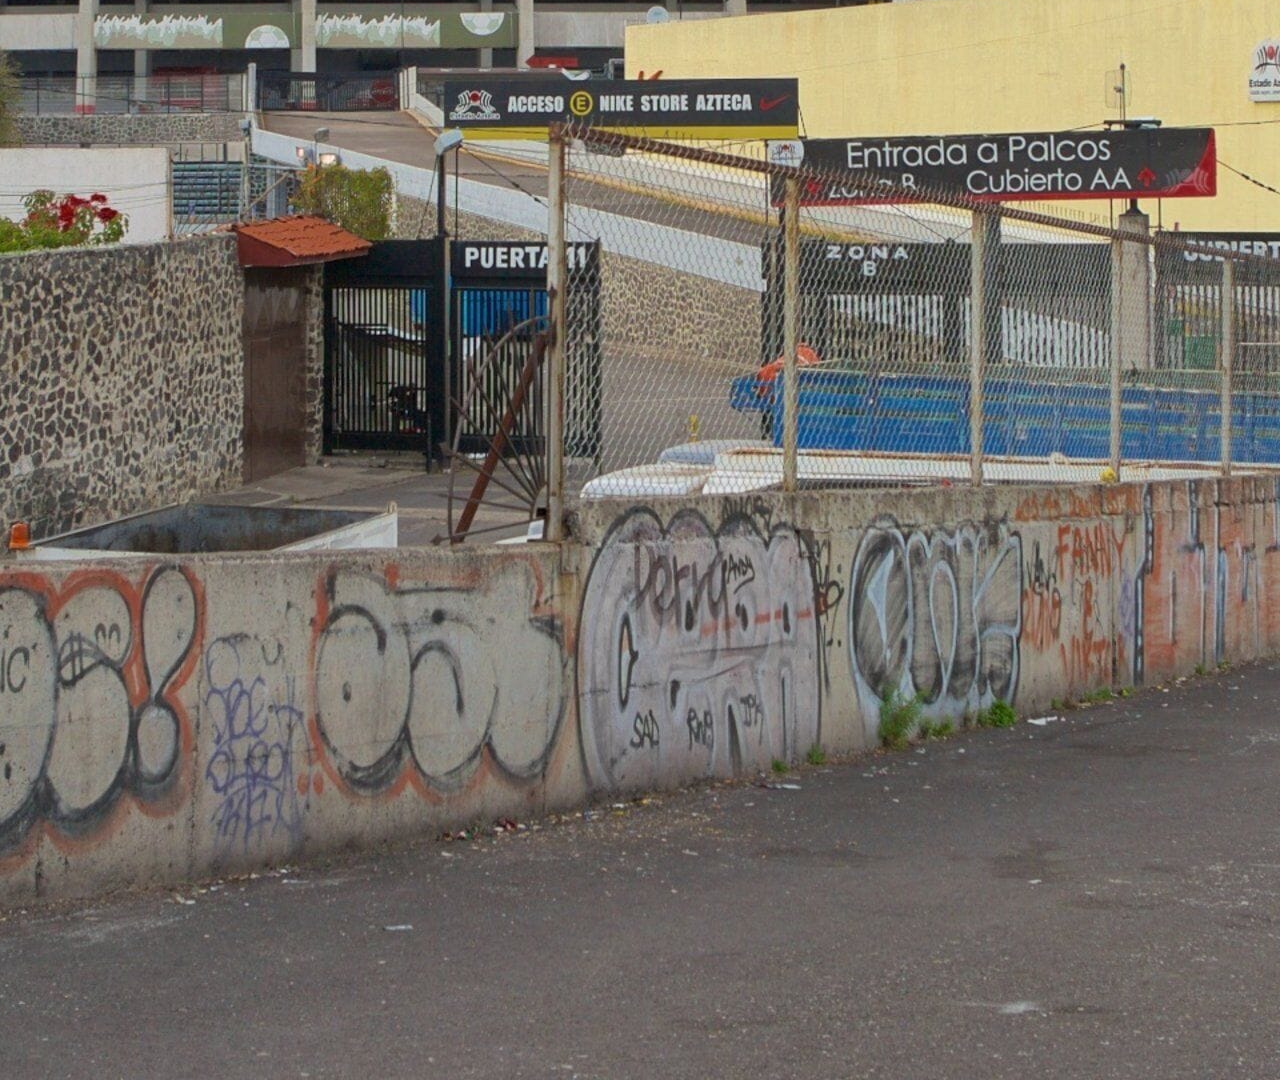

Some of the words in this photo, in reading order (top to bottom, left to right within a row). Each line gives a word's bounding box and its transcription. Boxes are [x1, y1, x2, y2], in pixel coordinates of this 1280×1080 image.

[508, 94, 565, 113] ACCESO
[599, 94, 634, 112] NIKE
[640, 94, 689, 112] STORE
[695, 93, 752, 112] AZTECA
[846, 138, 968, 169] Entrada
[976, 141, 999, 164] a
[1008, 135, 1112, 163] Palcos
[966, 168, 1082, 195] Cubierto
[1089, 169, 1132, 191] AA
[464, 246, 549, 269] PUERTA
[566, 246, 587, 269] 11
[825, 245, 909, 260] ZONA
[862, 260, 878, 277] B
